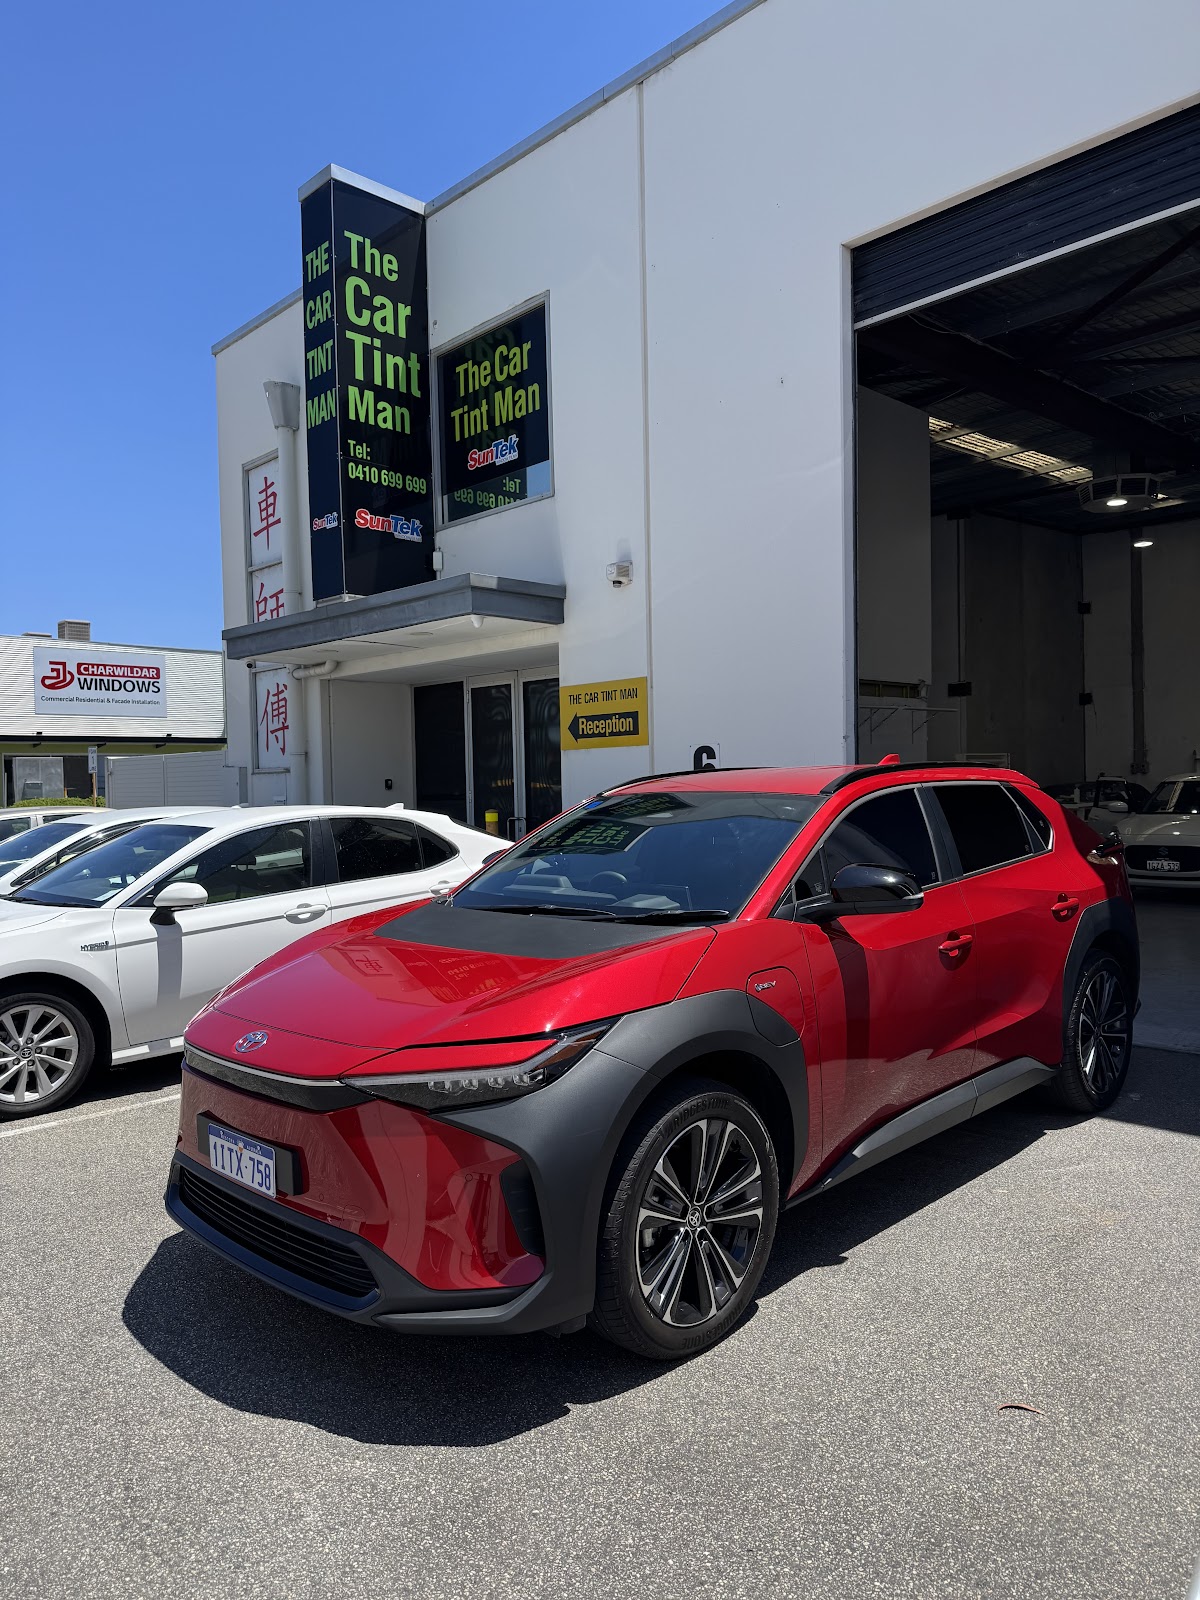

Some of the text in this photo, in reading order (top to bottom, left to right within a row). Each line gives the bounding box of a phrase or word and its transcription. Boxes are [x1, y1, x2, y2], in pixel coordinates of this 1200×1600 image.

[305, 240, 329, 283] THE
[344, 230, 399, 282] The
[306, 290, 332, 330] CAR
[345, 276, 412, 339] Car
[306, 339, 333, 380] TINT
[345, 330, 421, 398] Tint
[455, 340, 532, 398] The Car
[306, 388, 336, 430] MAN
[348, 385, 411, 435] Man
[451, 382, 541, 442] Tint Man
[348, 439, 371, 461] Tel:
[467, 434, 519, 471] SunTek
[348, 462, 427, 495] 0410 699 699
[313, 512, 338, 531] SunTek
[354, 508, 423, 537] SunTek
[77, 677, 161, 694] WINDOWS
[80, 664, 157, 678] CHARWILDAR
[131, 698, 161, 706] Installation
[568, 687, 638, 706] THE CAR TINT MAN
[578, 714, 634, 737] Reception
